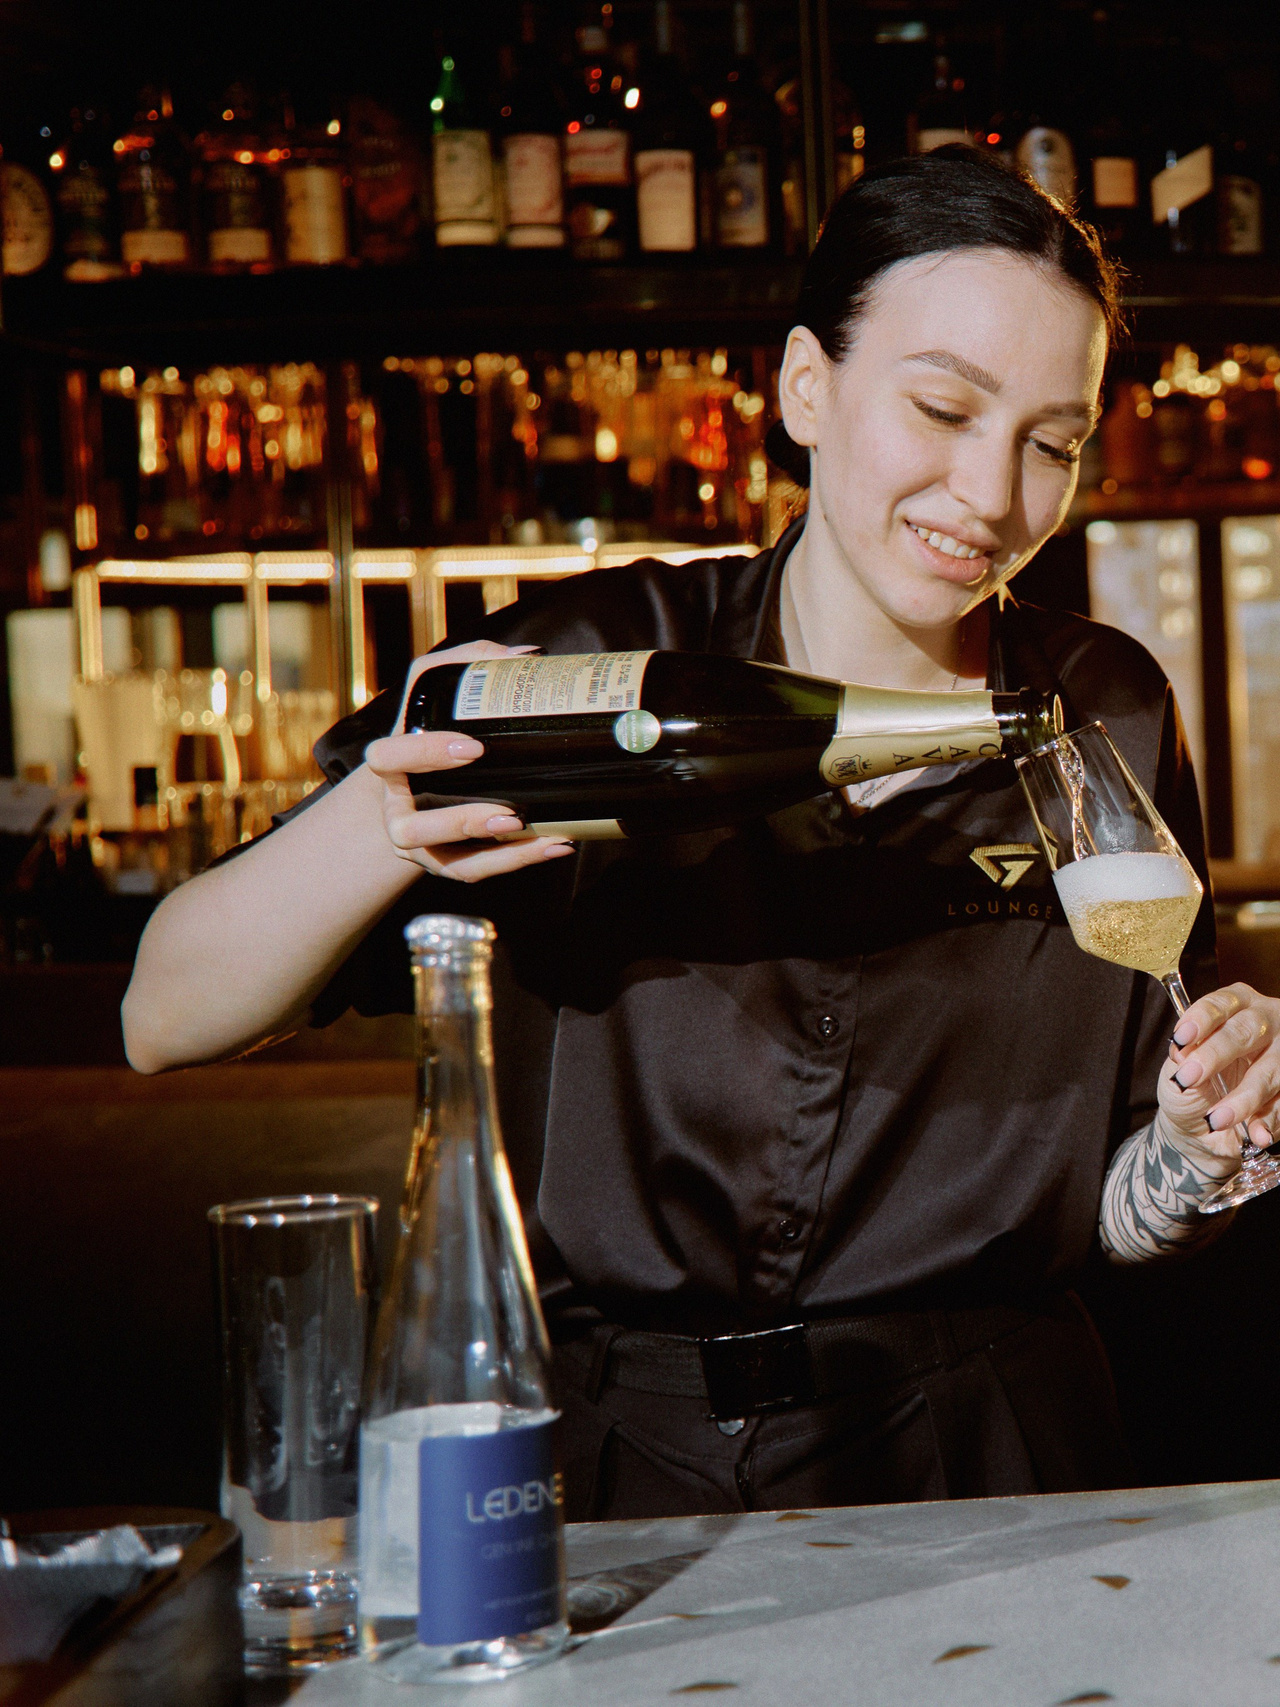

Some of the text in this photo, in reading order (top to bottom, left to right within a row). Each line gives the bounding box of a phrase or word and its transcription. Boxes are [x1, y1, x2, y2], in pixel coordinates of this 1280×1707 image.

[512, 673, 529, 713] ЗДОРОВЬЮ
[892, 742, 1001, 767] CAVA
[947, 900, 1052, 919] LOUNGE
